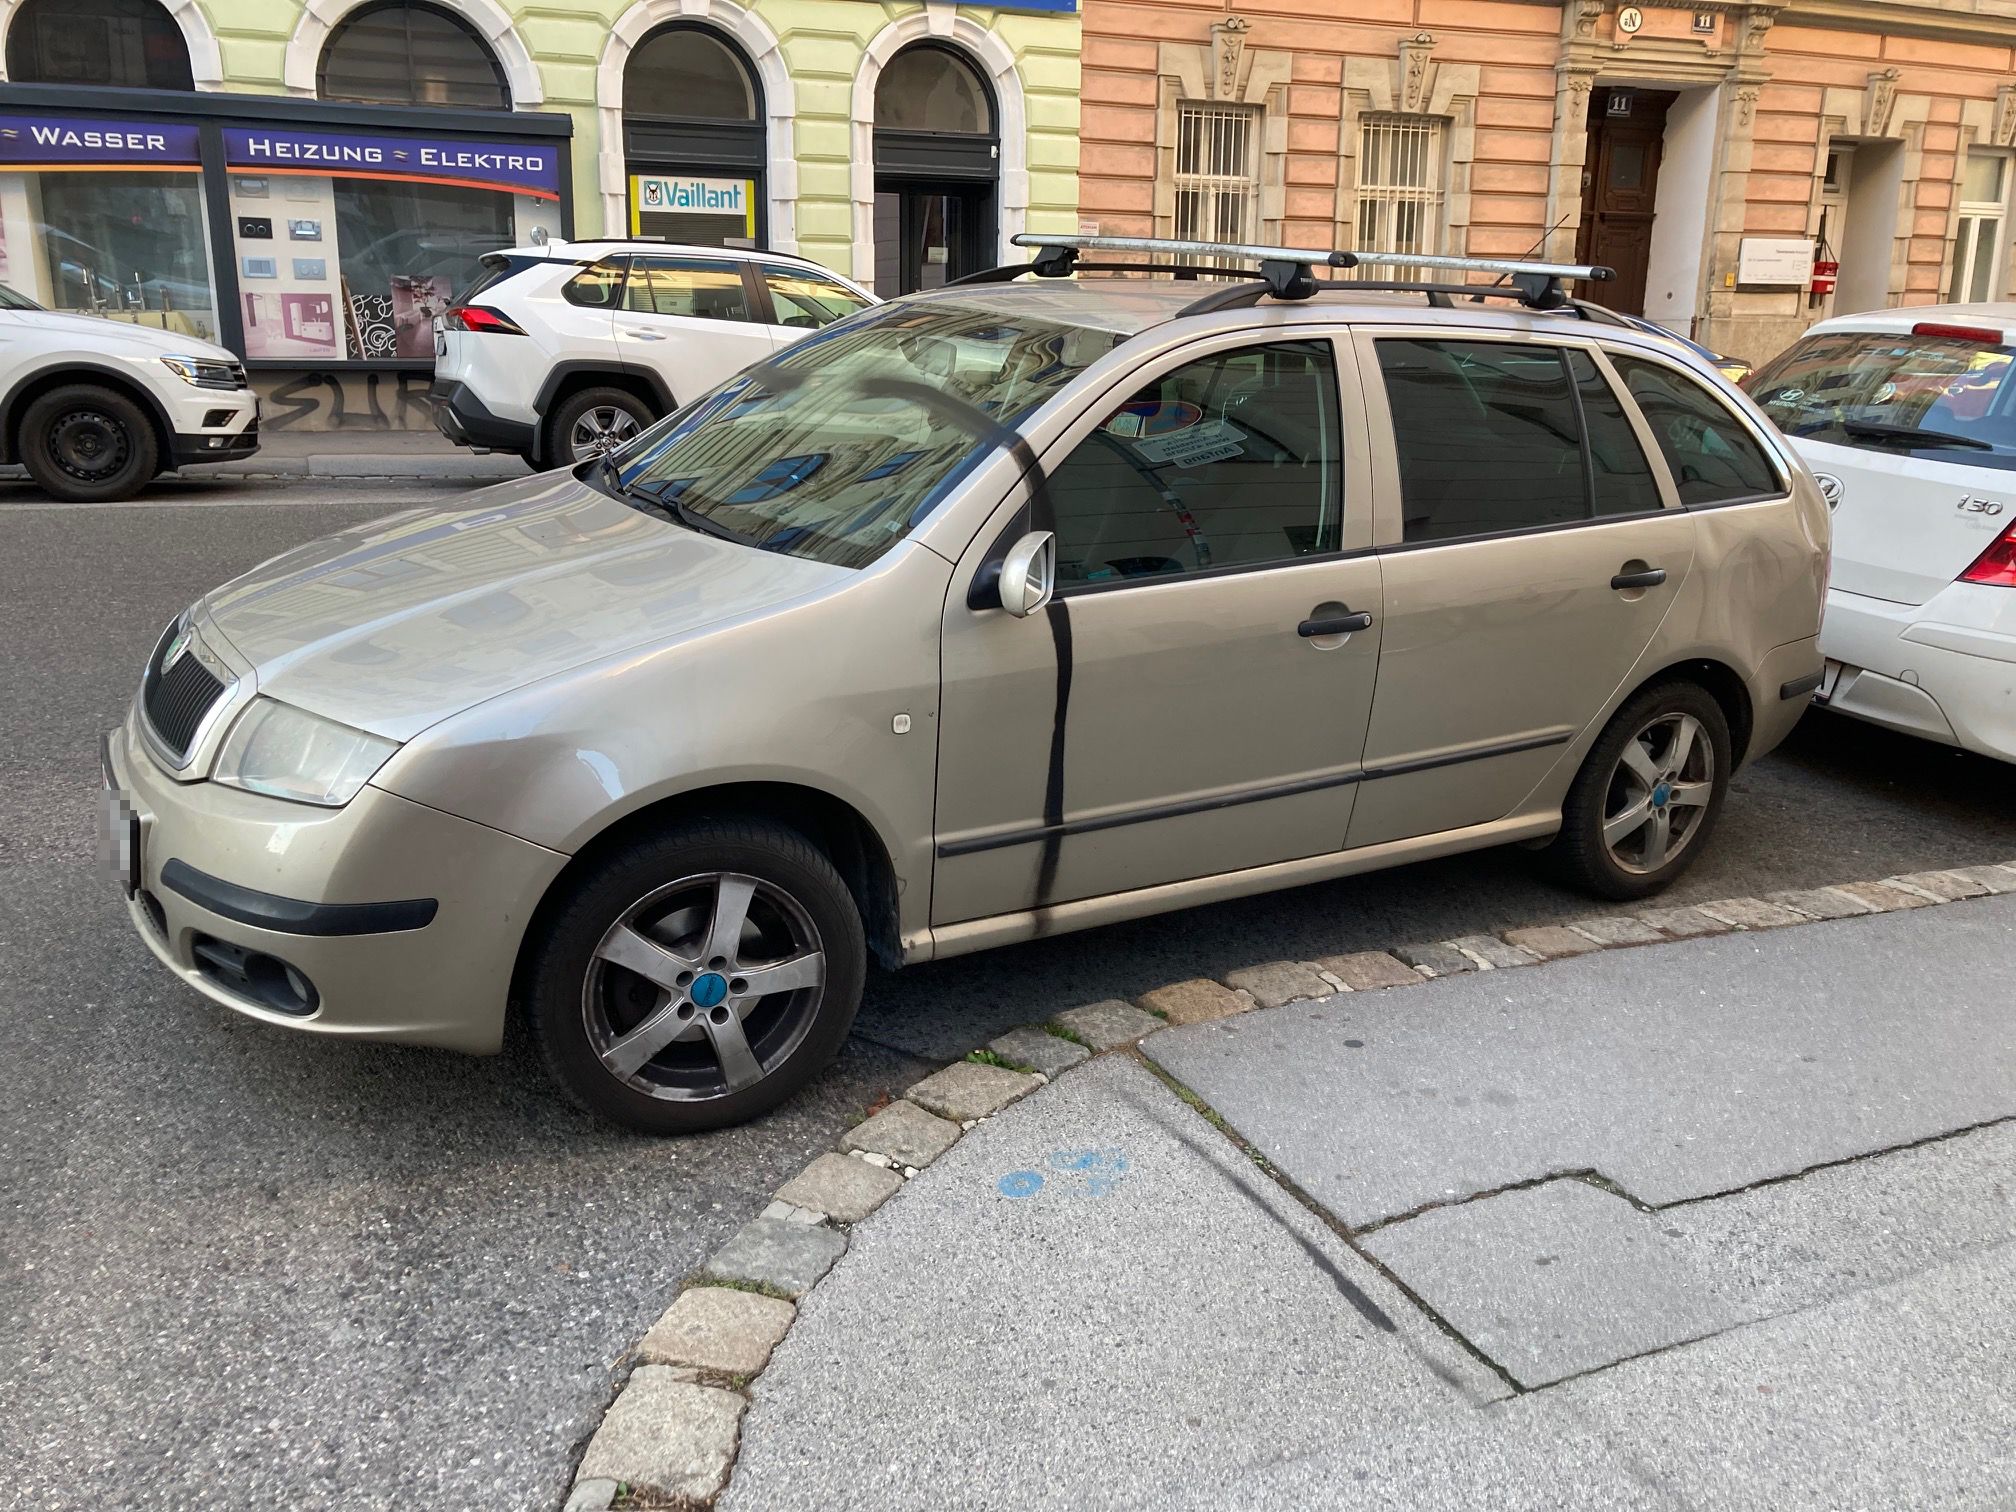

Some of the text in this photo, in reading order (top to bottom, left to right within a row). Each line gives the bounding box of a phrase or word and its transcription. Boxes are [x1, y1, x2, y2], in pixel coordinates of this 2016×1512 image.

[1698, 14, 1711, 27] 11
[1612, 96, 1627, 110] 11
[31, 126, 166, 150] WASSER
[248, 138, 543, 171] HEIZUNG ELEKTRO
[663, 182, 741, 209] Vaillant
